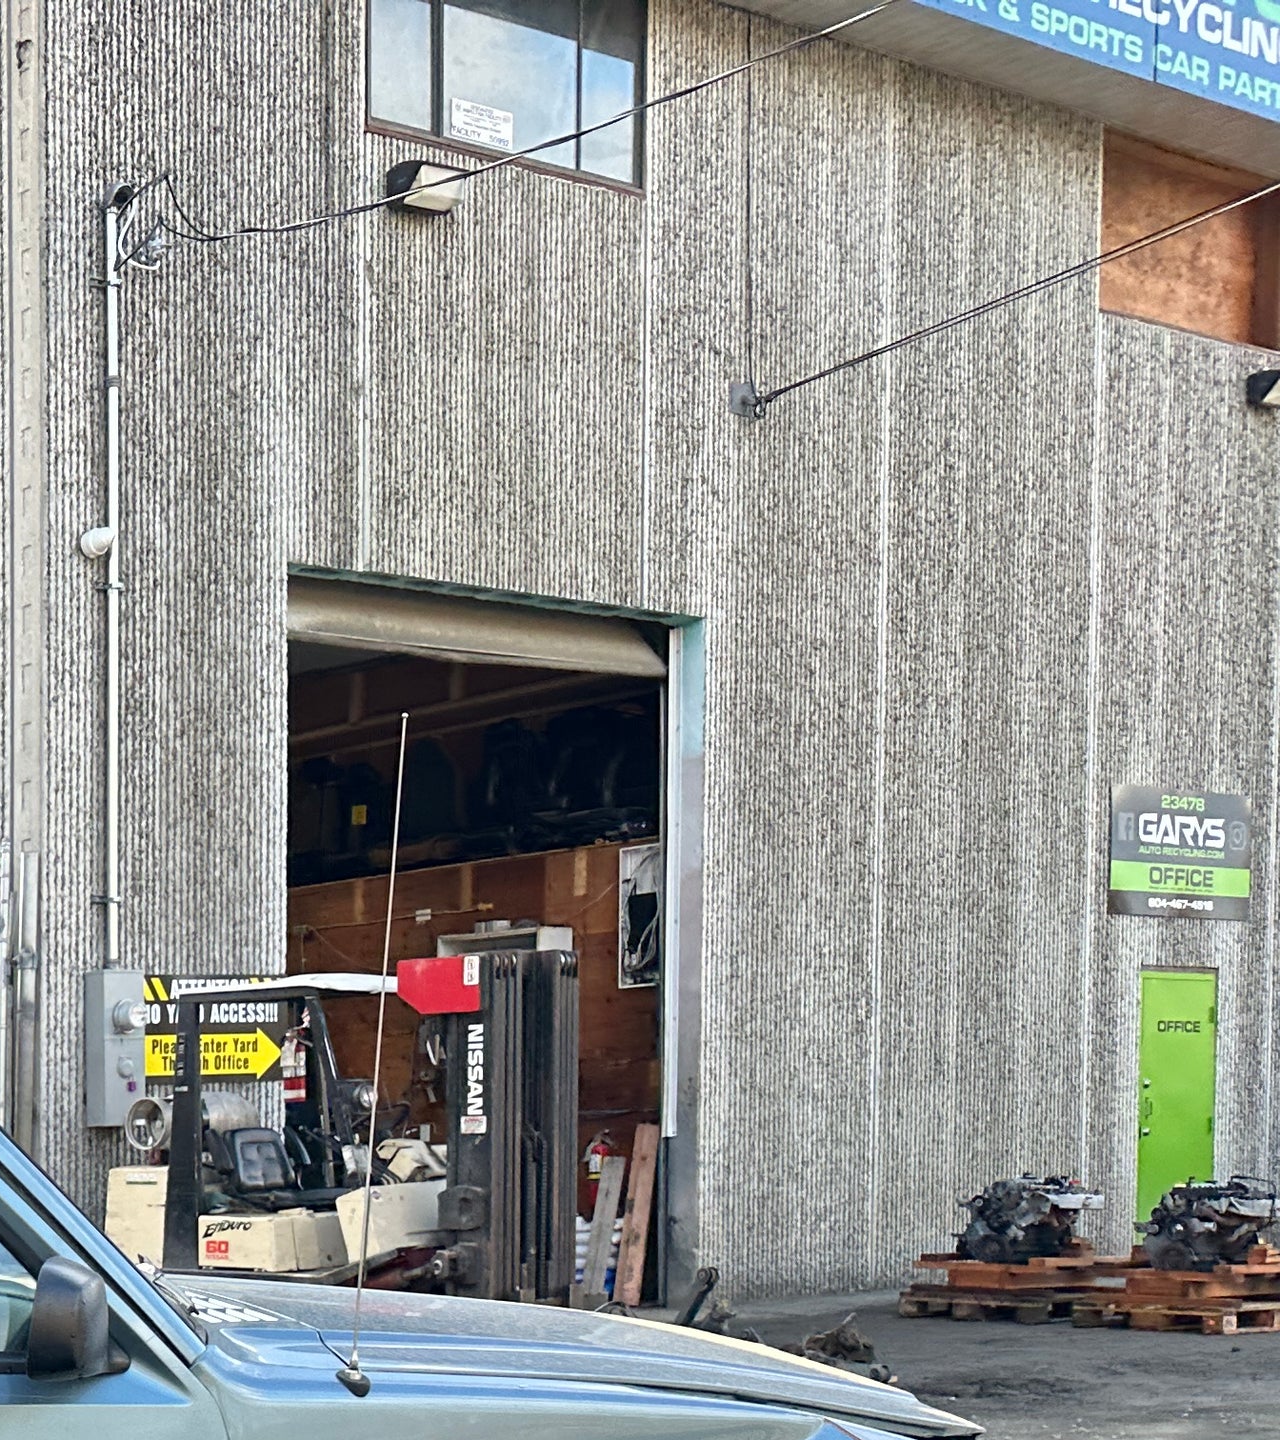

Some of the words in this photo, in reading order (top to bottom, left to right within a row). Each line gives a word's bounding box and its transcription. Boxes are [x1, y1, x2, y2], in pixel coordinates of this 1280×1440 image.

[1031, 2, 1143, 63] SPORTS
[1153, 43, 1210, 86] CAR
[1161, 794, 1205, 812] 23478
[1138, 812, 1226, 849] GARYS
[1138, 845, 1162, 855] AUTO
[1149, 866, 1214, 888] OFFICE
[209, 1003, 279, 1023] ACCESS!!!
[1157, 1020, 1201, 1033] OFFICE
[152, 1038, 177, 1055] Plea
[200, 1038, 228, 1054] nter
[232, 1037, 259, 1053] Yard
[214, 1054, 250, 1071] Office
[467, 1023, 484, 1115] NISSAN
[206, 1240, 229, 1253] 60
